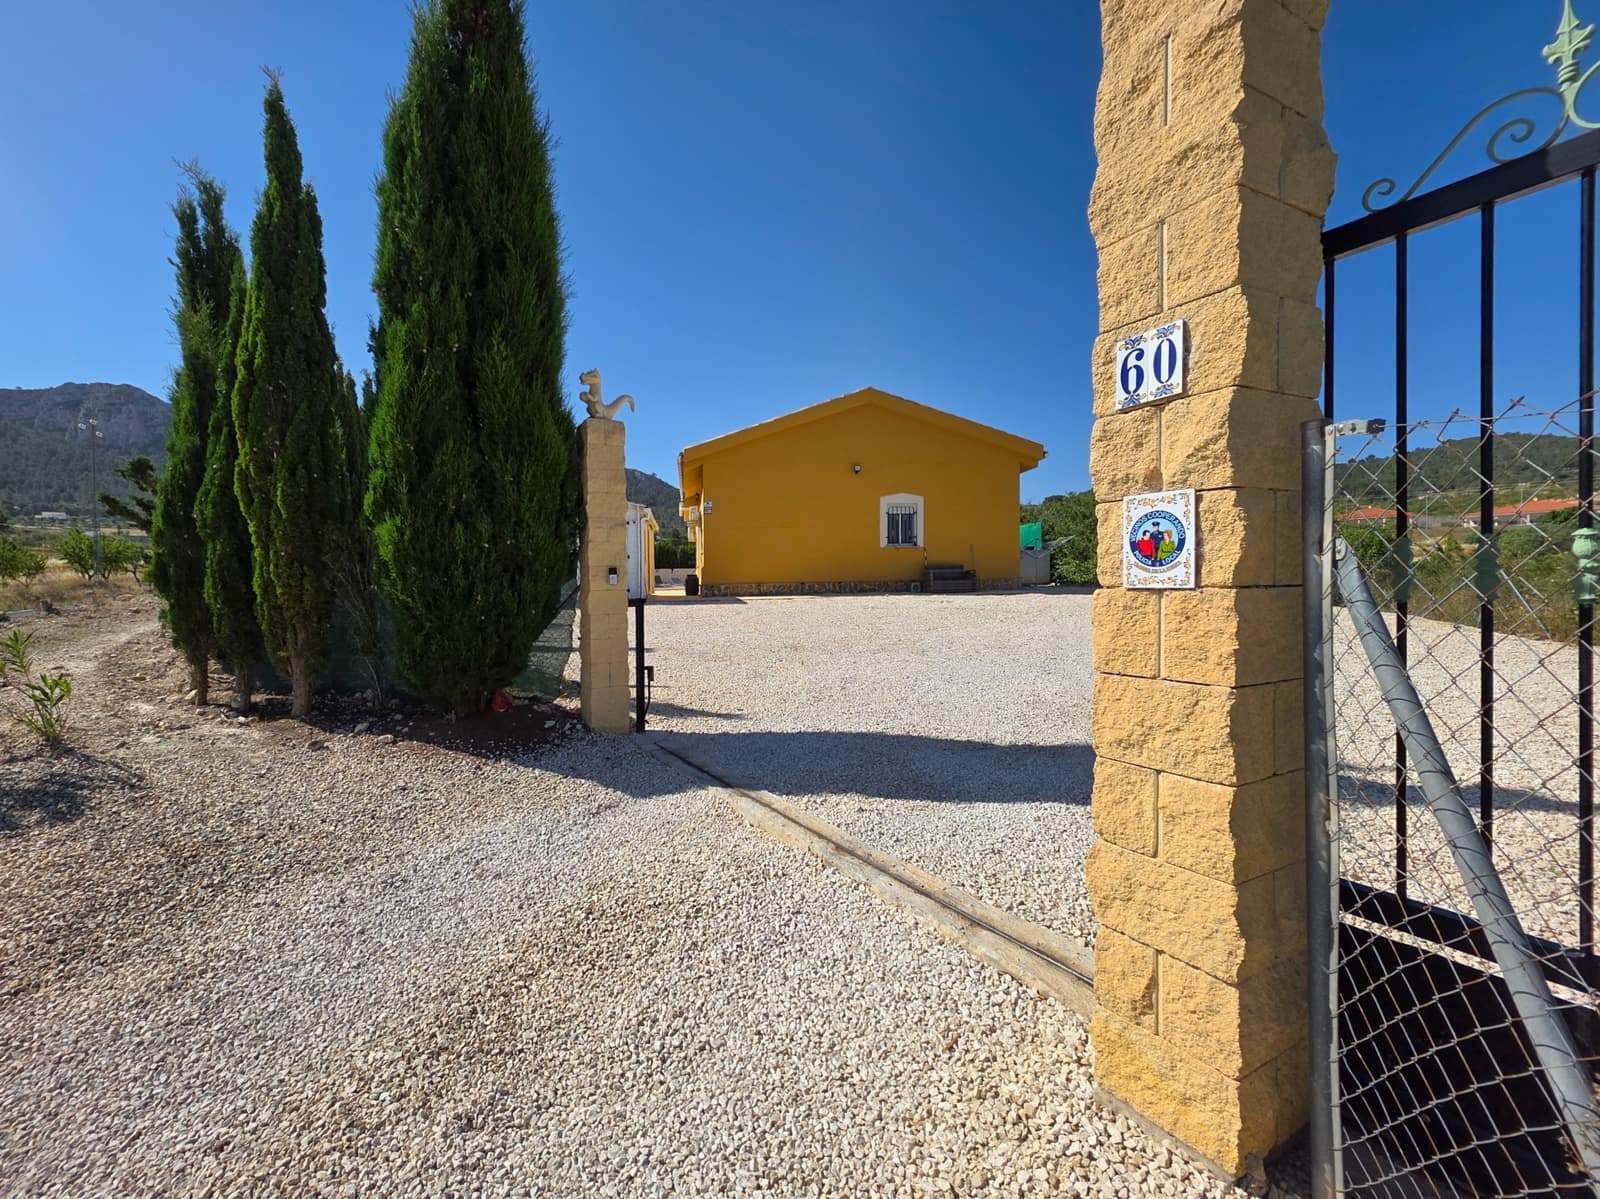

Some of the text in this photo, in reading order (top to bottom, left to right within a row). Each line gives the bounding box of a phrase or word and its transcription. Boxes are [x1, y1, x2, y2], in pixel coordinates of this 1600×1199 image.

[1120, 338, 1177, 395] 60
[1130, 511, 1185, 542] VECINOS COOPERANDO
[1161, 550, 1181, 565] LOCAL
